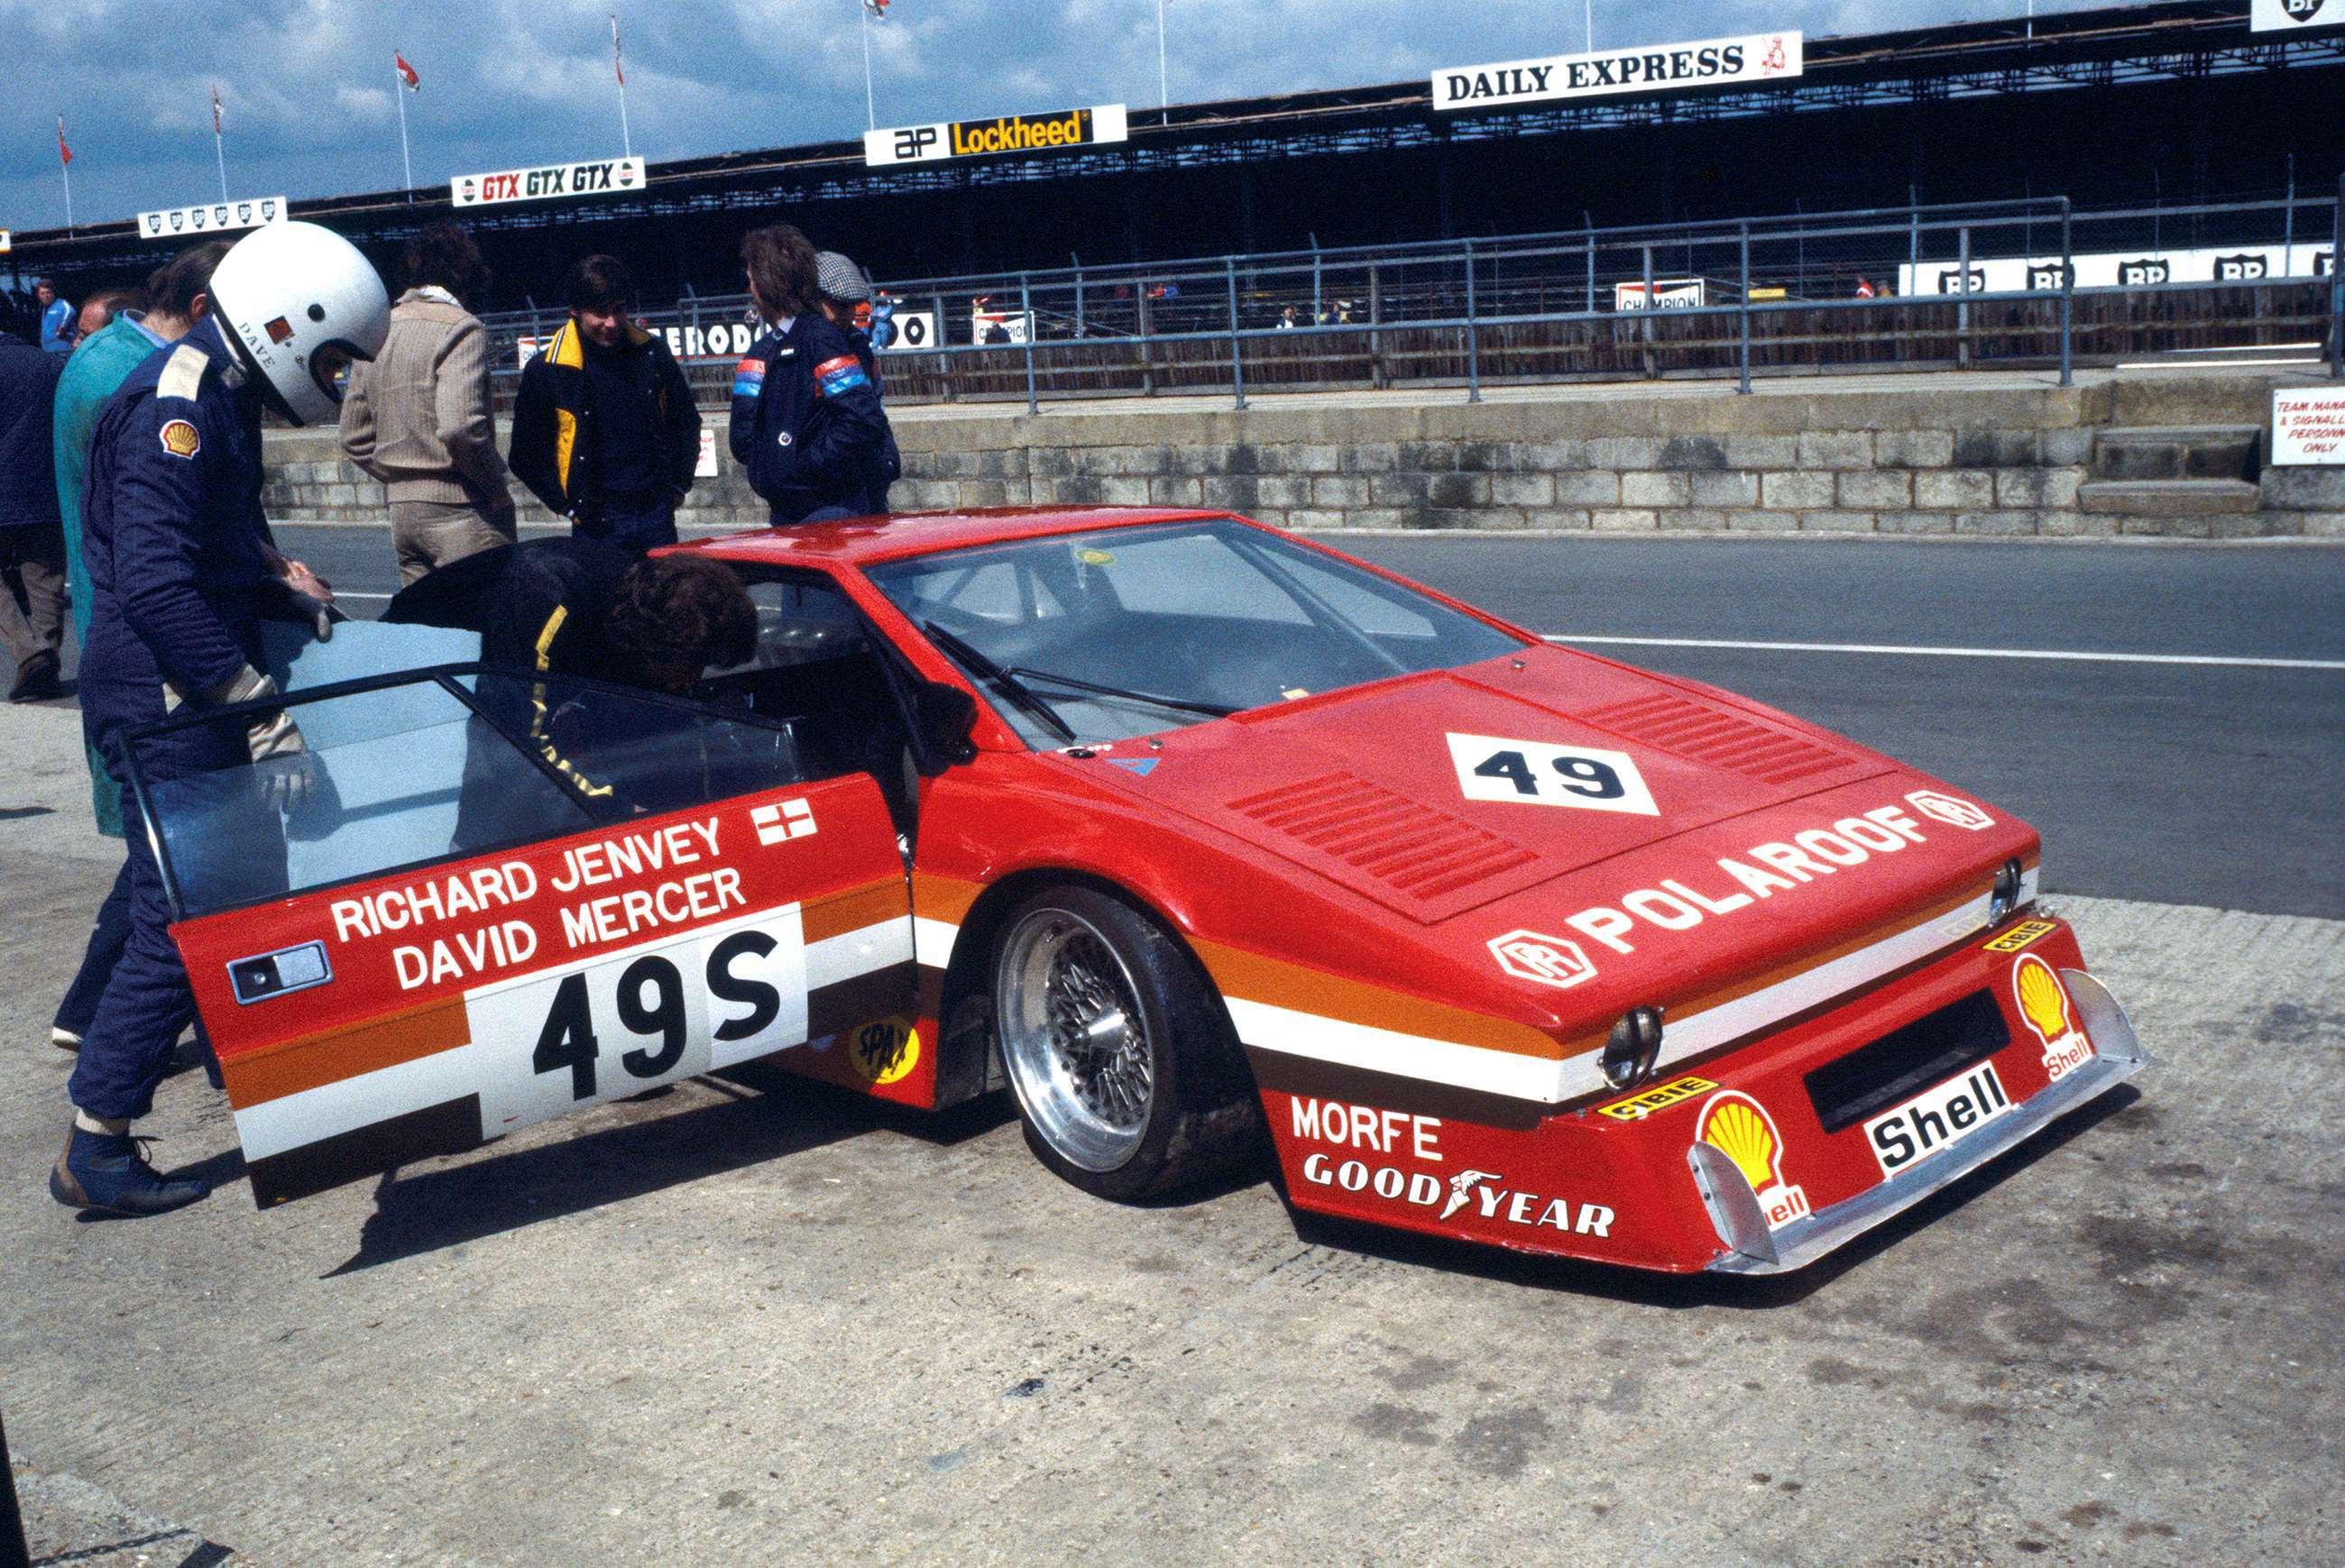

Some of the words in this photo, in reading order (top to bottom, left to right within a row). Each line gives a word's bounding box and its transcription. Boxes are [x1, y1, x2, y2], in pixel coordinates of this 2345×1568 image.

[1447, 65, 1553, 102] DAILY
[1568, 44, 1744, 89] EXPRESS
[952, 110, 1081, 156] Lockheed
[483, 173, 520, 201] GTX
[527, 168, 566, 197] GTX
[572, 163, 614, 192] GTX
[2126, 266, 2166, 285] BP
[2221, 261, 2265, 280] BP
[1623, 297, 1696, 310] CHMPION
[239, 322, 276, 369] DAVE
[2277, 401, 2310, 413] TEAM
[2302, 442, 2339, 454] ONLY
[1473, 749, 1626, 800] 49
[330, 860, 538, 943] RICHARD
[550, 817, 721, 893] JENVEY
[1565, 805, 1928, 956] POLAROOF
[392, 920, 538, 991] DAVID
[559, 867, 748, 949] MERCER
[2046, 1039, 2089, 1077] Shell
[1291, 1096, 1443, 1161] MORFE
[1873, 1068, 2007, 1169] Shell
[1765, 1191, 1805, 1227] ell
